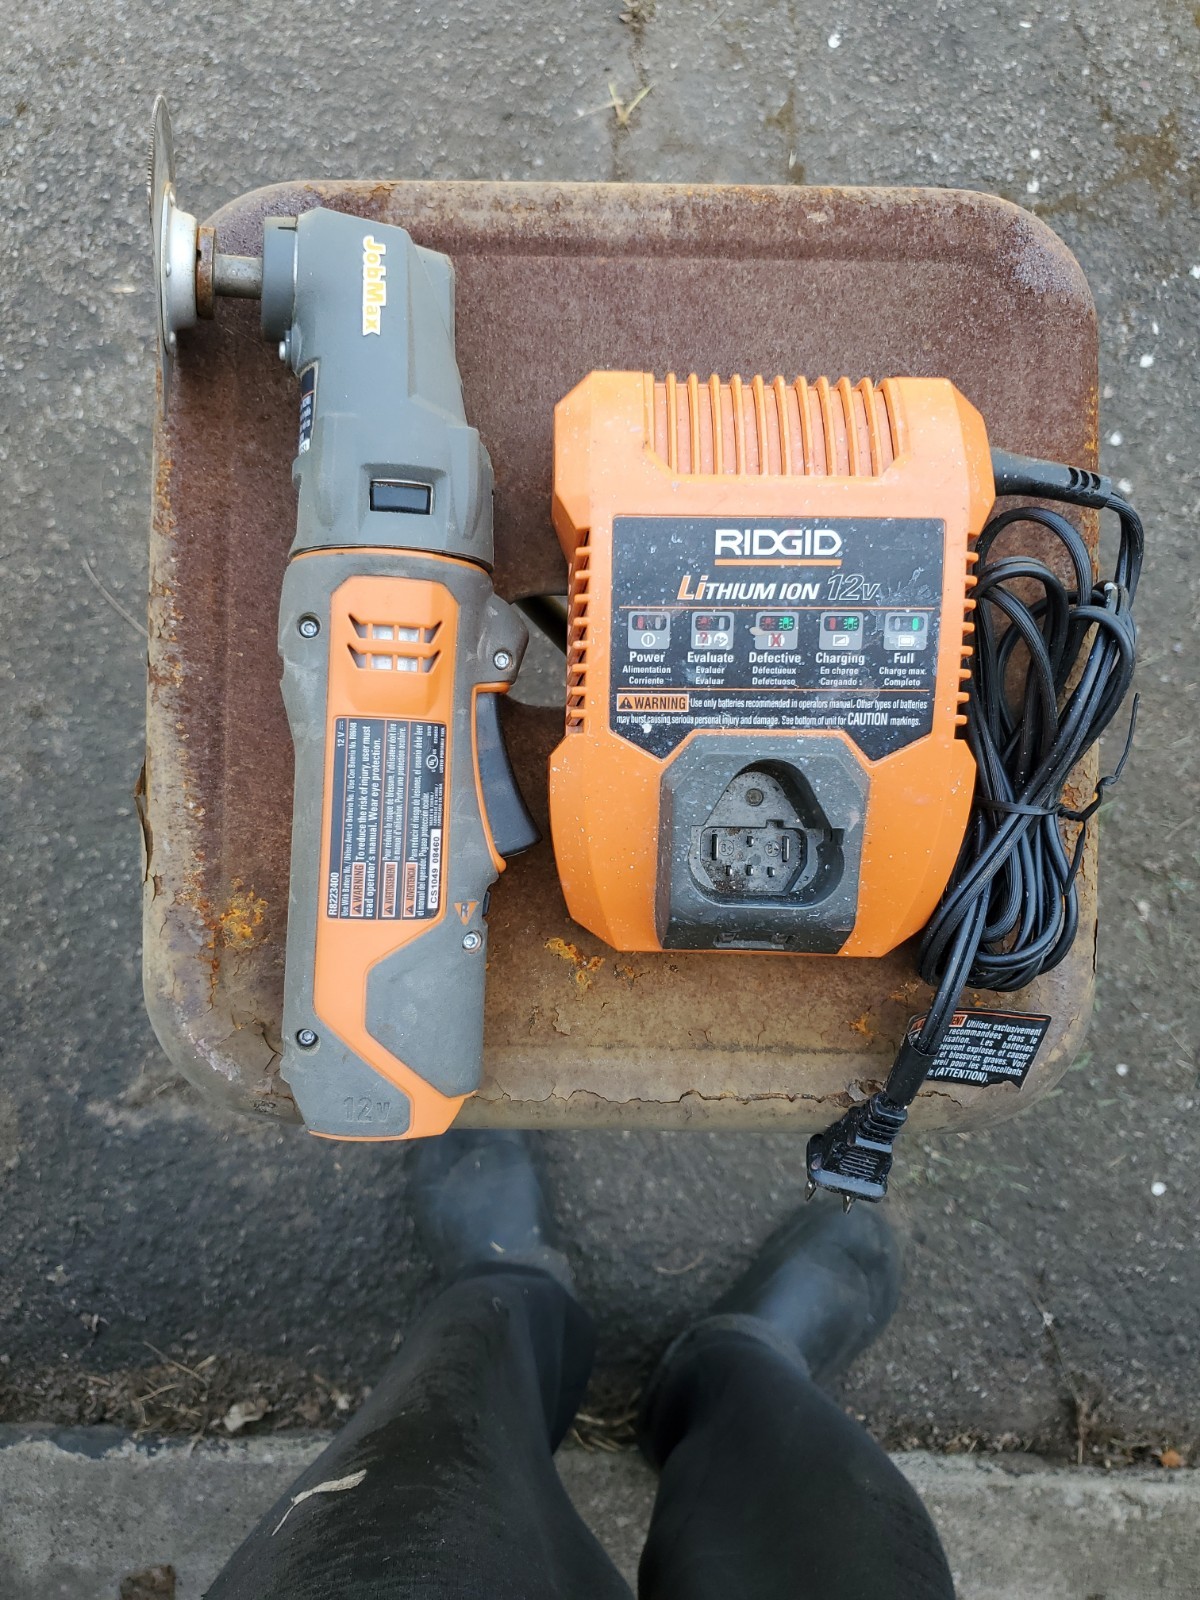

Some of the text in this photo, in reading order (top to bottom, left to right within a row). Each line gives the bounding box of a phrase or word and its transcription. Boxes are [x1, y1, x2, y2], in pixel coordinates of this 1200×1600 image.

[364, 237, 386, 331] JobMax
[714, 529, 843, 556] RIDGID
[779, 582, 820, 600] ION
[629, 651, 665, 663] Power
[687, 651, 734, 663] Evaluate
[749, 651, 802, 664] Defective
[815, 652, 865, 666] Charging
[893, 652, 915, 664] Full
[622, 665, 671, 674] Alimentation
[695, 666, 725, 674] Evaluer
[752, 666, 797, 675] Défectueux
[820, 666, 859, 676] En charge
[878, 666, 907, 676] Charge
[628, 677, 665, 685] Corriente
[695, 677, 725, 685] Evaluar
[752, 677, 796, 686] Defectuoso
[820, 678, 857, 687] Cargando
[883, 678, 921, 687] Completo
[634, 696, 687, 710] WARNING
[690, 698, 702, 708] Use
[703, 698, 716, 710] only
[717, 698, 745, 708] batteries
[745, 699, 789, 709] recommended
[790, 699, 797, 708] in
[856, 699, 874, 709] Other
[874, 699, 892, 711] types
[892, 699, 900, 709] of
[900, 699, 927, 710] batteries
[616, 712, 921, 728] may burst causing serious personal injury and damage. See bottom of unit for CAUTION markings.
[362, 726, 371, 744] must
[337, 738, 345, 747] 12
[359, 762, 372, 786] injury,
[358, 796, 368, 810] risk
[358, 811, 367, 823] the
[384, 805, 396, 822] risque
[410, 806, 422, 823] riesgo
[364, 738, 382, 917] read operator's manual. Wear eye protection.
[356, 824, 366, 850] reduce
[355, 851, 366, 861] To
[382, 849, 392, 861] Pour
[408, 849, 418, 861] Para
[342, 874, 352, 892] Battery
[353, 864, 364, 903] WARNING
[328, 872, 339, 916] R8223400
[341, 906, 349, 916] Use
[966, 1019, 992, 1030] Utiliser
[992, 1023, 1042, 1037] exclusivement
[948, 1028, 1038, 1045] recommandées dans le
[979, 1037, 994, 1047] Les
[1001, 1041, 1035, 1053] batteries
[938, 1050, 1027, 1069] et blessures graves. Voir
[966, 1045, 996, 1056] exploser
[997, 1047, 1005, 1057] et
[1006, 1049, 1031, 1060] causer
[934, 1067, 989, 1083] (ATTENTION).
[949, 1059, 967, 1069] pour
[968, 1060, 981, 1070] les
[980, 1062, 1023, 1077] autocollants
